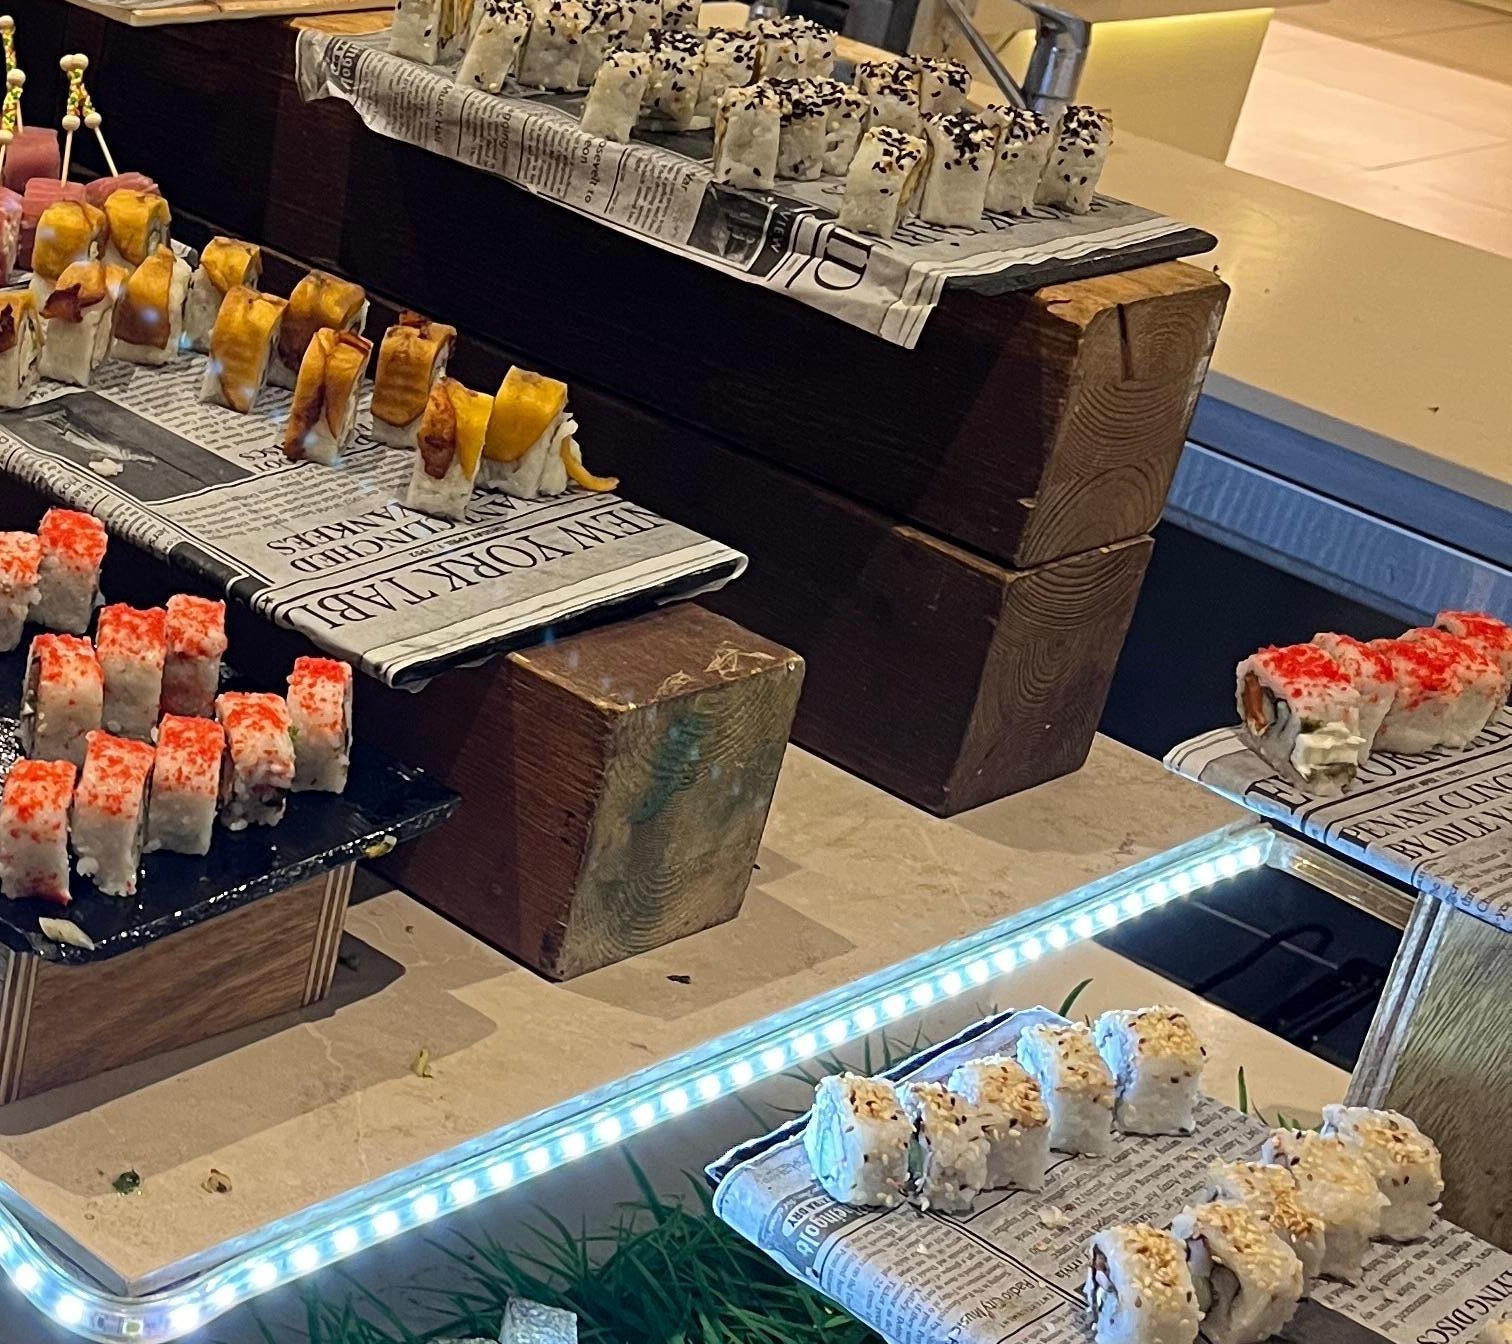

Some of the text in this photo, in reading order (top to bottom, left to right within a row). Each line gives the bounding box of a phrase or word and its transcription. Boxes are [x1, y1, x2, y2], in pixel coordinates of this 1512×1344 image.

[769, 210, 788, 253] VIEW
[262, 498, 413, 559] YANKEES
[284, 508, 453, 577] CLINCHED
[411, 524, 573, 601] YORK
[1338, 801, 1449, 854] PENANT
[1384, 832, 1437, 860] BY
[787, 1200, 854, 1258] eingold
[997, 1275, 1036, 1305] Radio
[950, 1305, 990, 1340] Music
